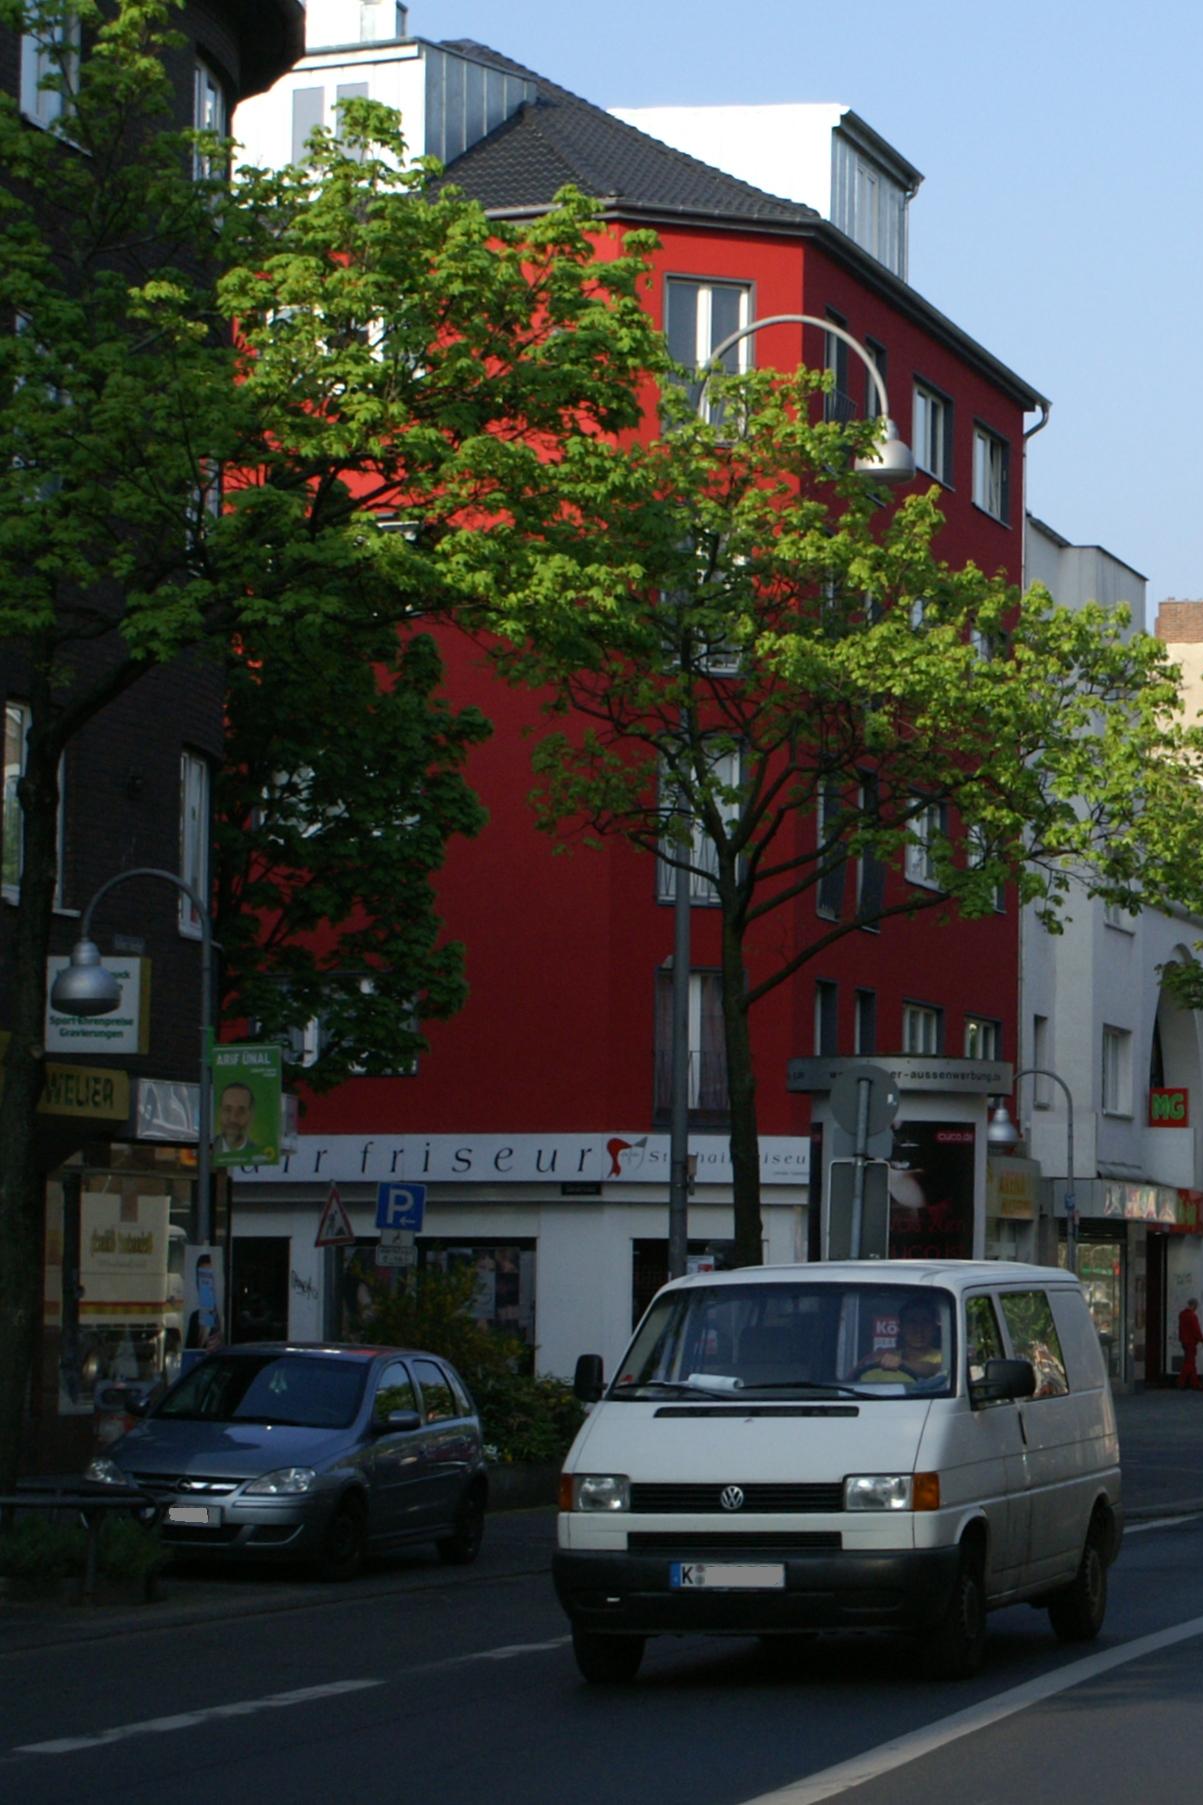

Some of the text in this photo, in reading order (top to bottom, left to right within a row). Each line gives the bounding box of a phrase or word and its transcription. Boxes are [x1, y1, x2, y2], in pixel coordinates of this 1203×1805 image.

[216, 1053, 238, 1066] ARIF
[1151, 1092, 1185, 1120] MG
[358, 1140, 592, 1174] friseur
[386, 1189, 415, 1225] P
[876, 1319, 898, 1335] Kö
[682, 1566, 694, 1585] K
